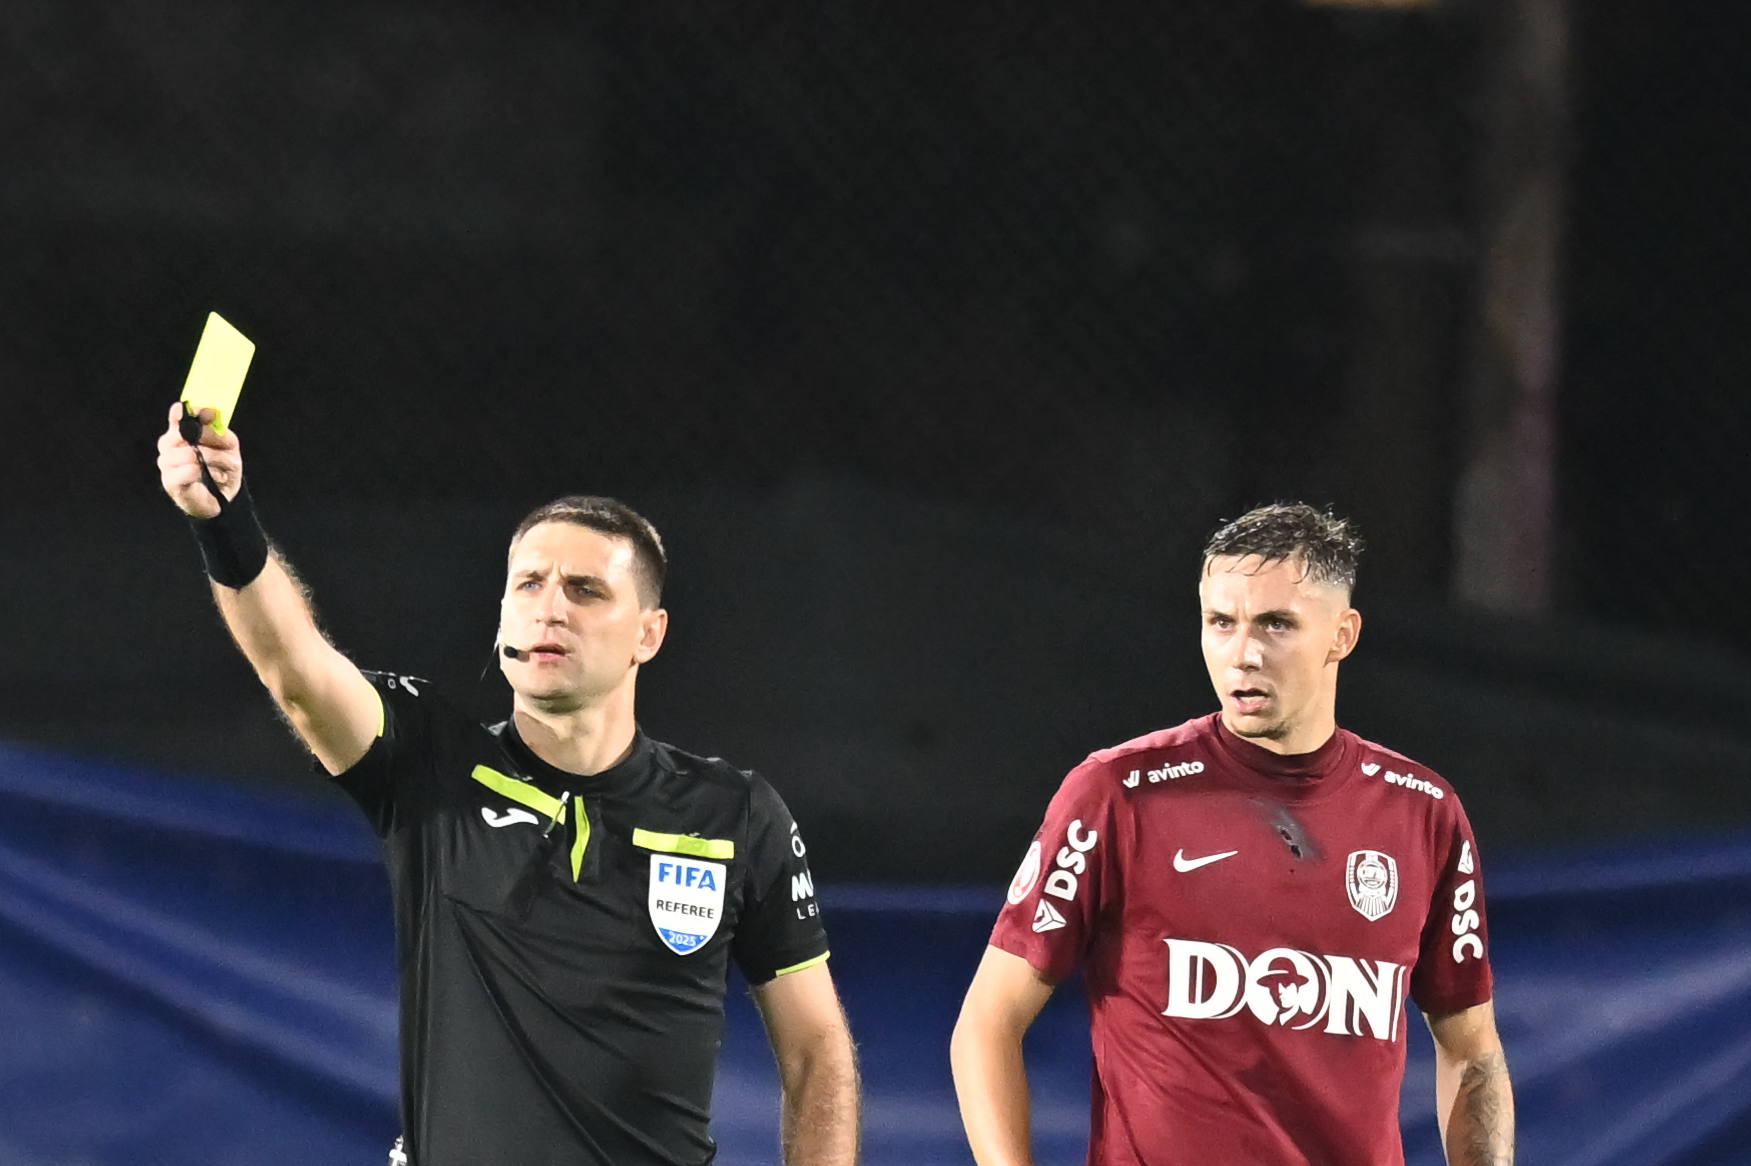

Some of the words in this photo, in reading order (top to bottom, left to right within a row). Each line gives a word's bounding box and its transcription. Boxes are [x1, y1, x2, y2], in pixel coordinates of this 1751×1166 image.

[1147, 761, 1205, 783] avinto
[1384, 770, 1444, 799] avinto
[1044, 819, 1098, 901] DSC
[658, 862, 716, 892] FIFA
[656, 899, 715, 919] REFEREE
[1451, 880, 1484, 964] DSC
[668, 930, 697, 947] 2025
